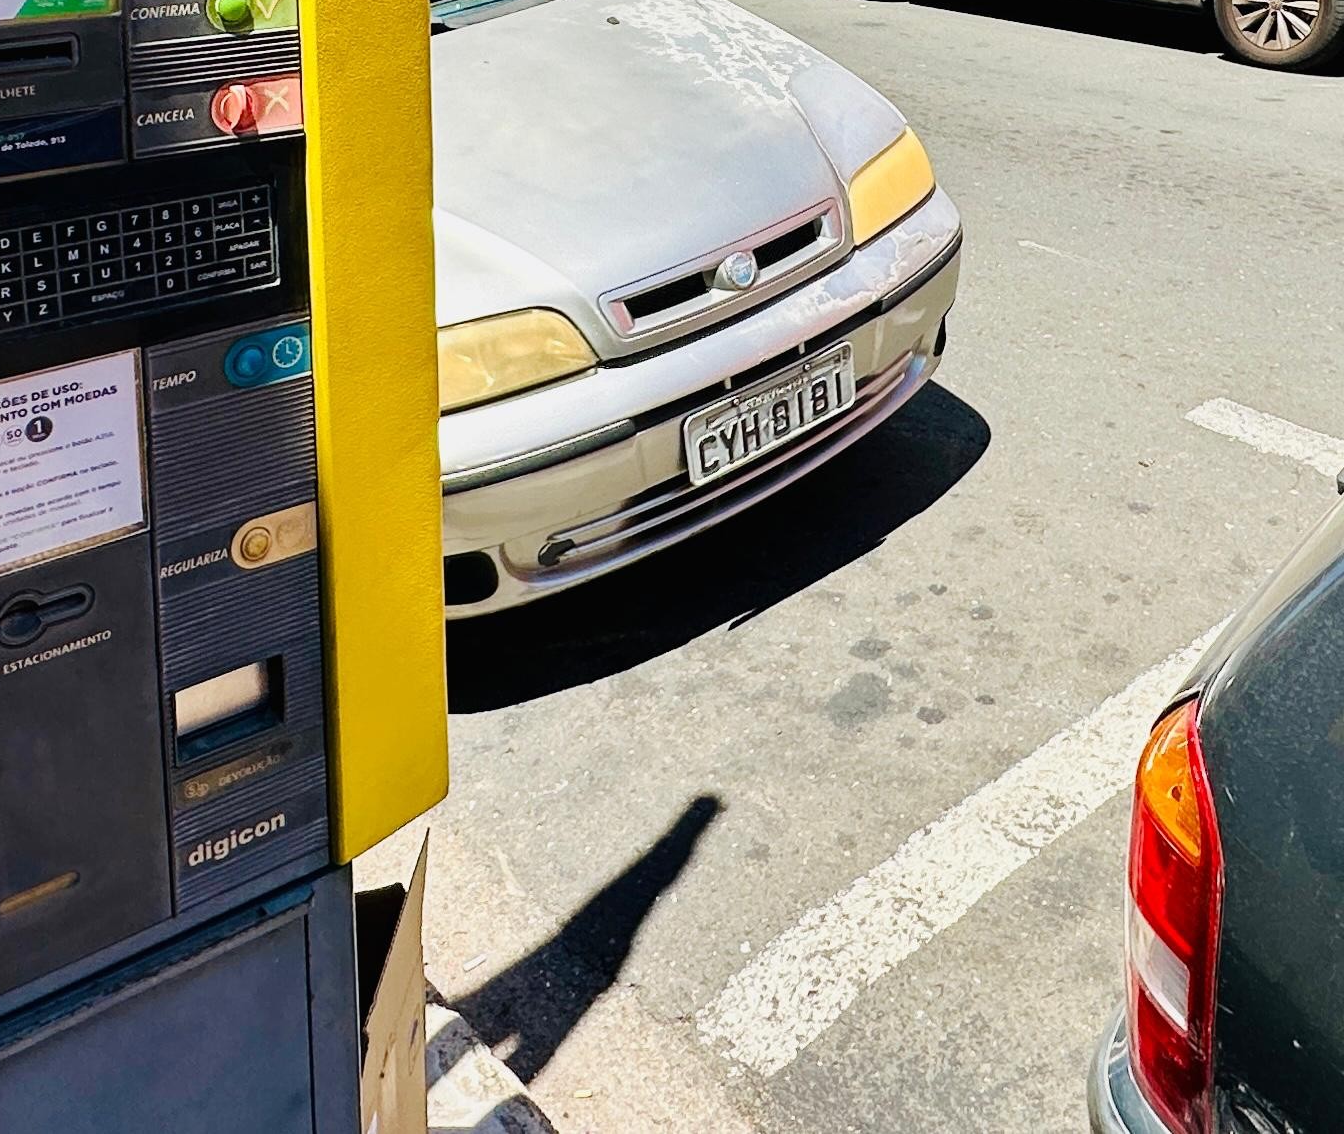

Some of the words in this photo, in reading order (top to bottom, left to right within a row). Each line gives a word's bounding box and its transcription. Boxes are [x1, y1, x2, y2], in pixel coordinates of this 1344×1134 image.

[130, 2, 201, 21] CONFIRMA
[136, 108, 195, 127] CANCELA
[1, 143, 13, 152] de
[0, 238, 10, 249] D
[33, 232, 42, 243] E
[67, 226, 75, 237] F
[96, 221, 107, 231] G
[131, 215, 138, 226] 7
[192, 204, 199, 215] 9
[1, 262, 12, 273] K
[34, 257, 43, 267] L
[68, 249, 79, 261] M
[100, 244, 109, 255] N
[133, 237, 141, 248] 4
[165, 233, 172, 242] 5
[1, 287, 11, 298] R
[37, 280, 46, 291] S
[72, 273, 80, 284] T
[101, 267, 110, 278] U
[135, 262, 141, 271] 1
[165, 256, 172, 266] 2
[195, 250, 202, 260] 3
[3, 311, 12, 322] Y
[39, 304, 48, 315] Z
[91, 290, 125, 303] ESPAÇO
[31, 389, 49, 402] DE
[53, 382, 84, 396] USO:
[152, 370, 197, 392] TEMPO
[31, 400, 61, 414] COM
[64, 385, 118, 407] MOEDAS
[6, 428, 23, 440] 50
[33, 419, 43, 434] 1
[160, 549, 228, 579] REGULARIZA
[3, 630, 112, 675] ESTACIONAMENTO
[218, 753, 281, 786] DEVOLUÇÃO
[188, 812, 286, 867] digicon
